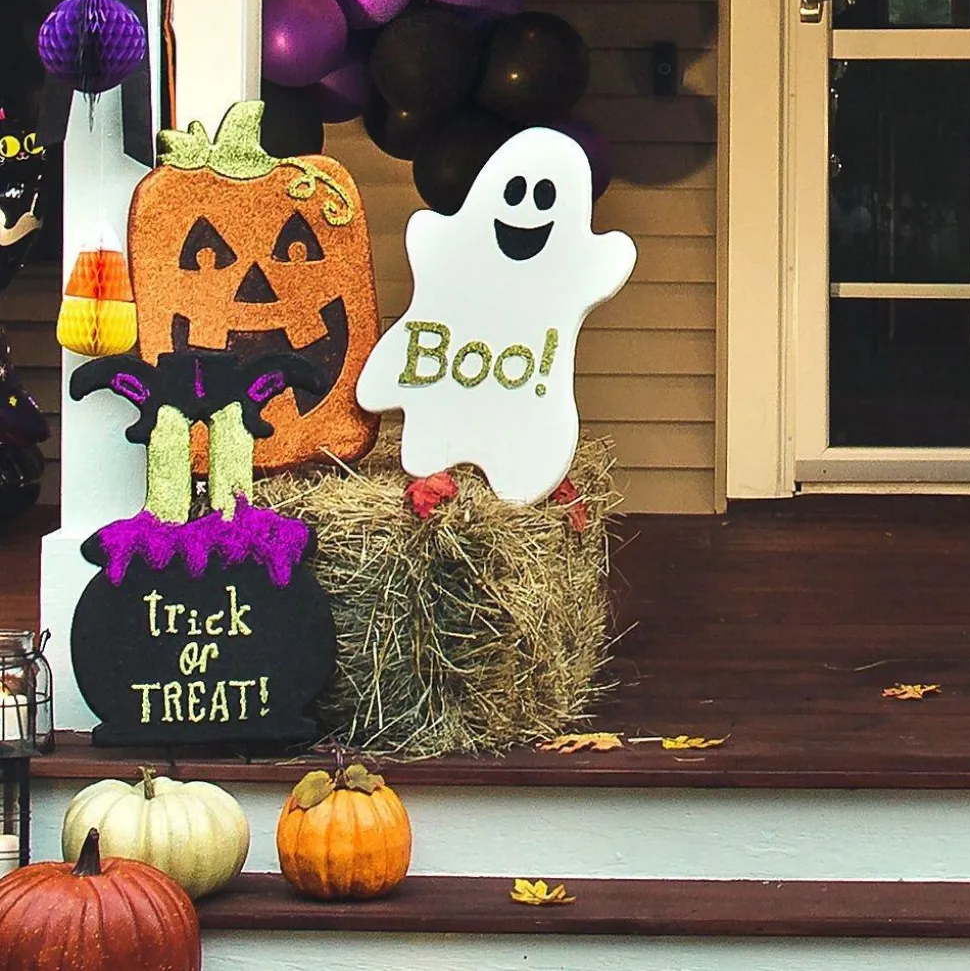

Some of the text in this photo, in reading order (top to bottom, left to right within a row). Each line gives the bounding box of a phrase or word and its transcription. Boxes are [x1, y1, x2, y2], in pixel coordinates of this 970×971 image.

[398, 320, 559, 398] Boo!
[179, 641, 219, 675] or
[131, 676, 270, 723] TREAT!
